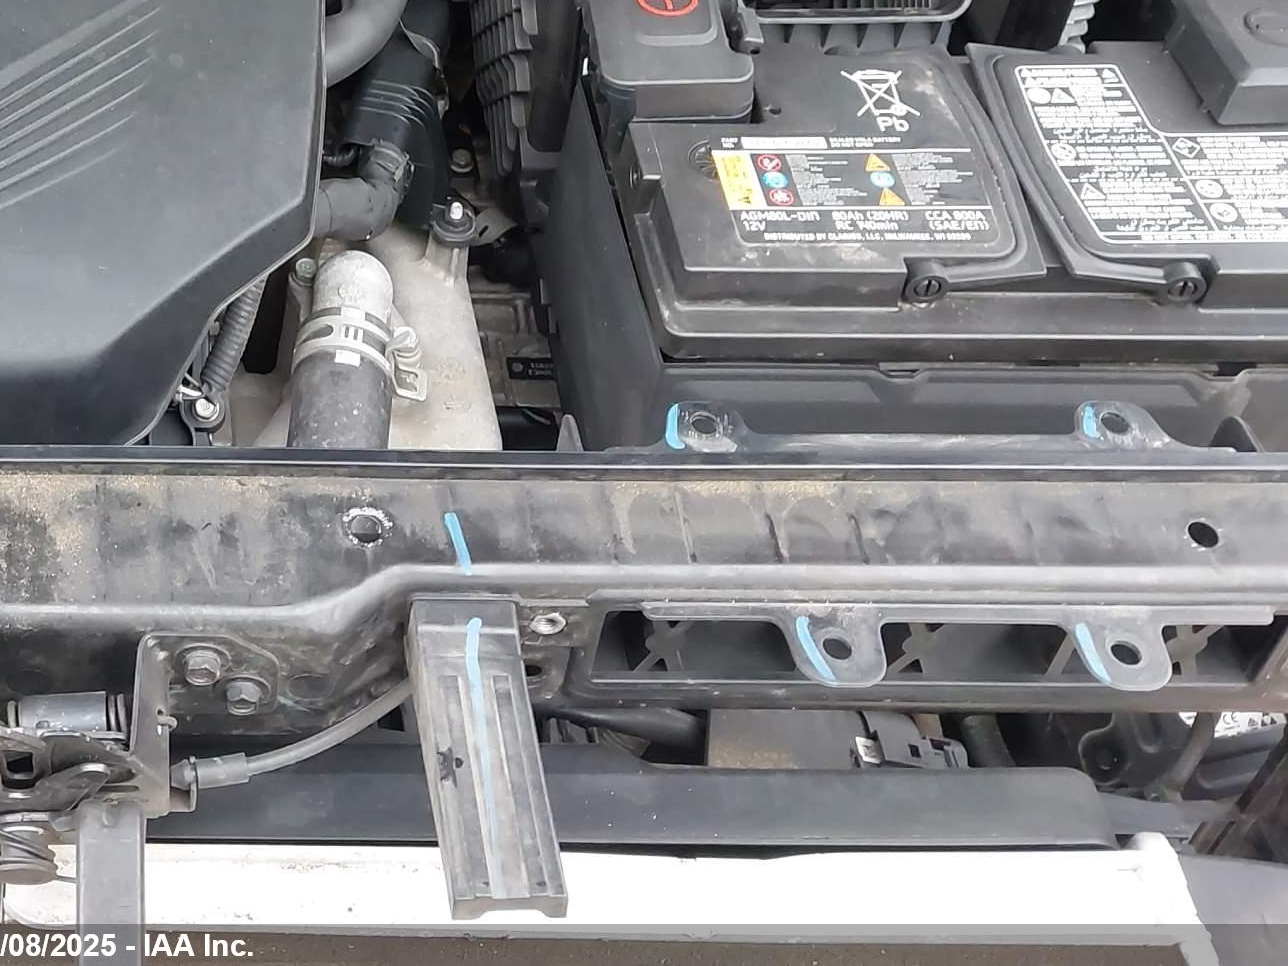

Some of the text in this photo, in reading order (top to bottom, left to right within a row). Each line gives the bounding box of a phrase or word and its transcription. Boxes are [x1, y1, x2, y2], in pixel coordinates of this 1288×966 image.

[875, 116, 910, 132] Pb
[924, 210, 951, 221] CCA
[953, 210, 985, 221] 800A
[742, 220, 766, 231] 12V
[836, 220, 853, 231] RC
